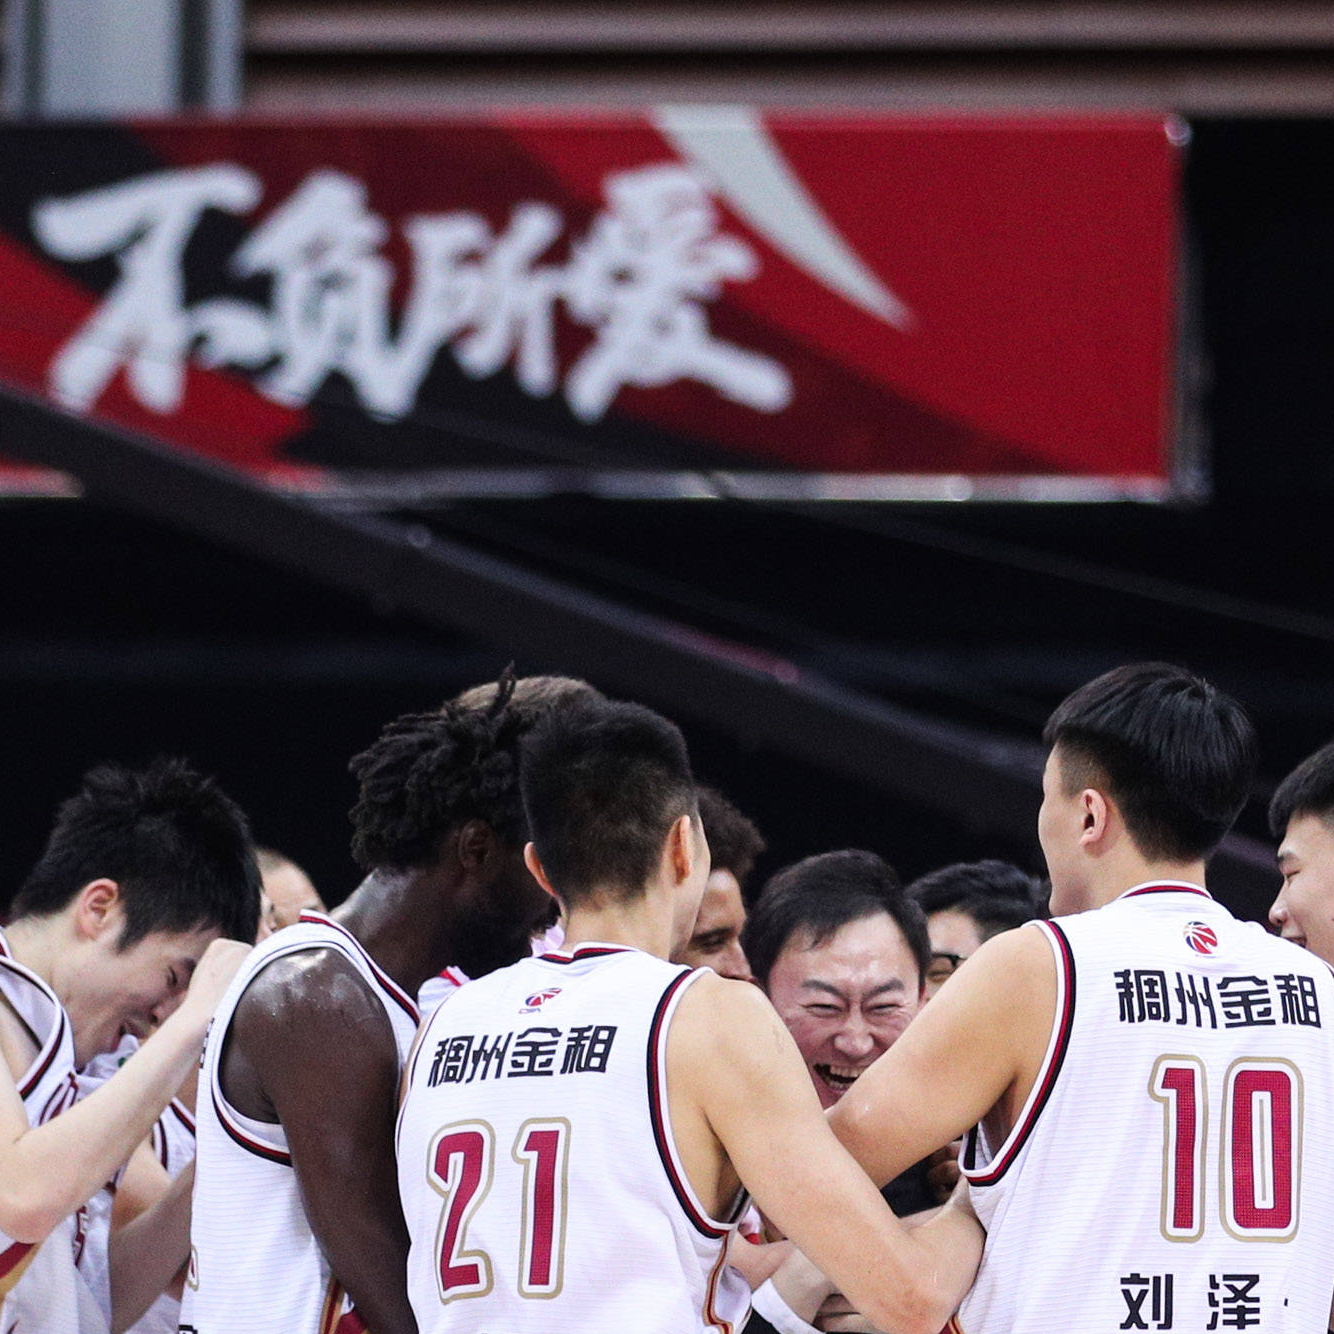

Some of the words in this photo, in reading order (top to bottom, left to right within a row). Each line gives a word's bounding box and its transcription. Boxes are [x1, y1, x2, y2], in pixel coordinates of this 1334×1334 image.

[33, 163, 792, 422] 不负所爱
[427, 1024, 617, 1088] 稠州金租
[1114, 968, 1322, 1030] 稠州金租
[426, 1117, 571, 1305] 21
[1148, 1053, 1304, 1244] 10
[1119, 1272, 1289, 1331] 刘泽
